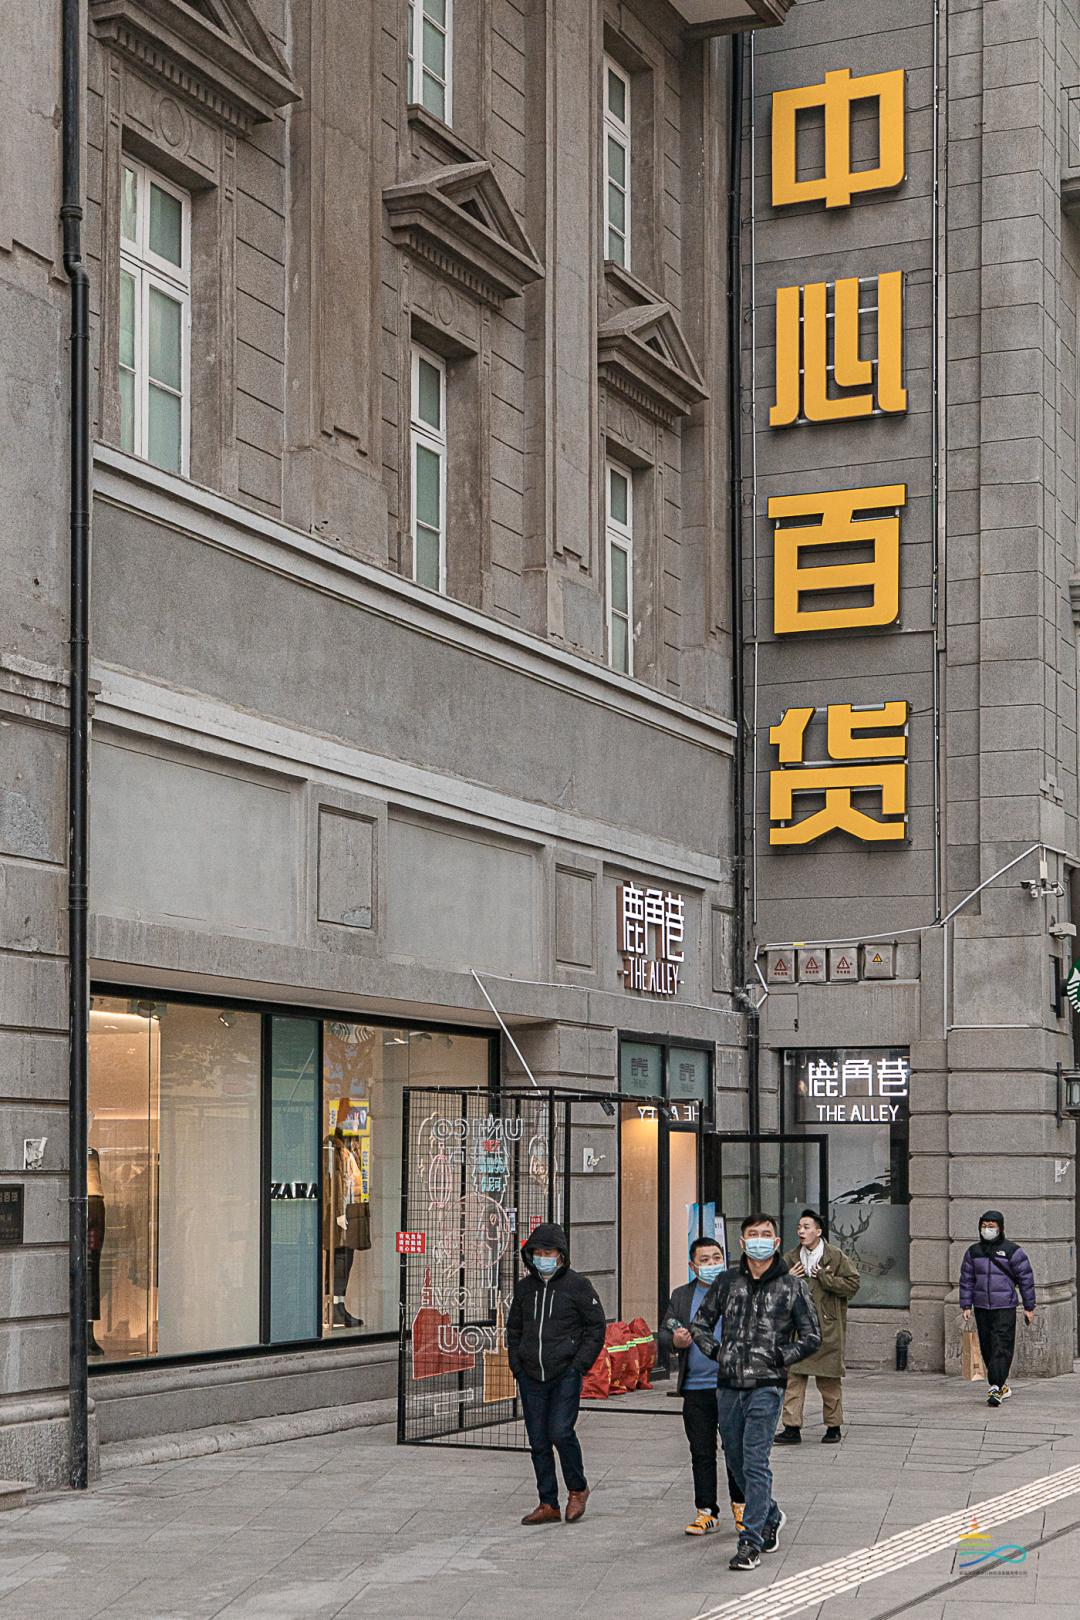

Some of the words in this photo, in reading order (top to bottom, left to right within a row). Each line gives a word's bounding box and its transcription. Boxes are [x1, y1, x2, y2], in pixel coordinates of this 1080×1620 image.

[769, 67, 907, 848] 中心百货
[622, 881, 685, 962] 鹿角巷
[628, 956, 648, 990] THE
[649, 960, 679, 995] ALLEY
[808, 1058, 908, 1097] 鹿角巷
[816, 1105, 847, 1121] THE
[850, 1105, 899, 1121] ALLEY
[270, 1183, 319, 1199] ZARA
